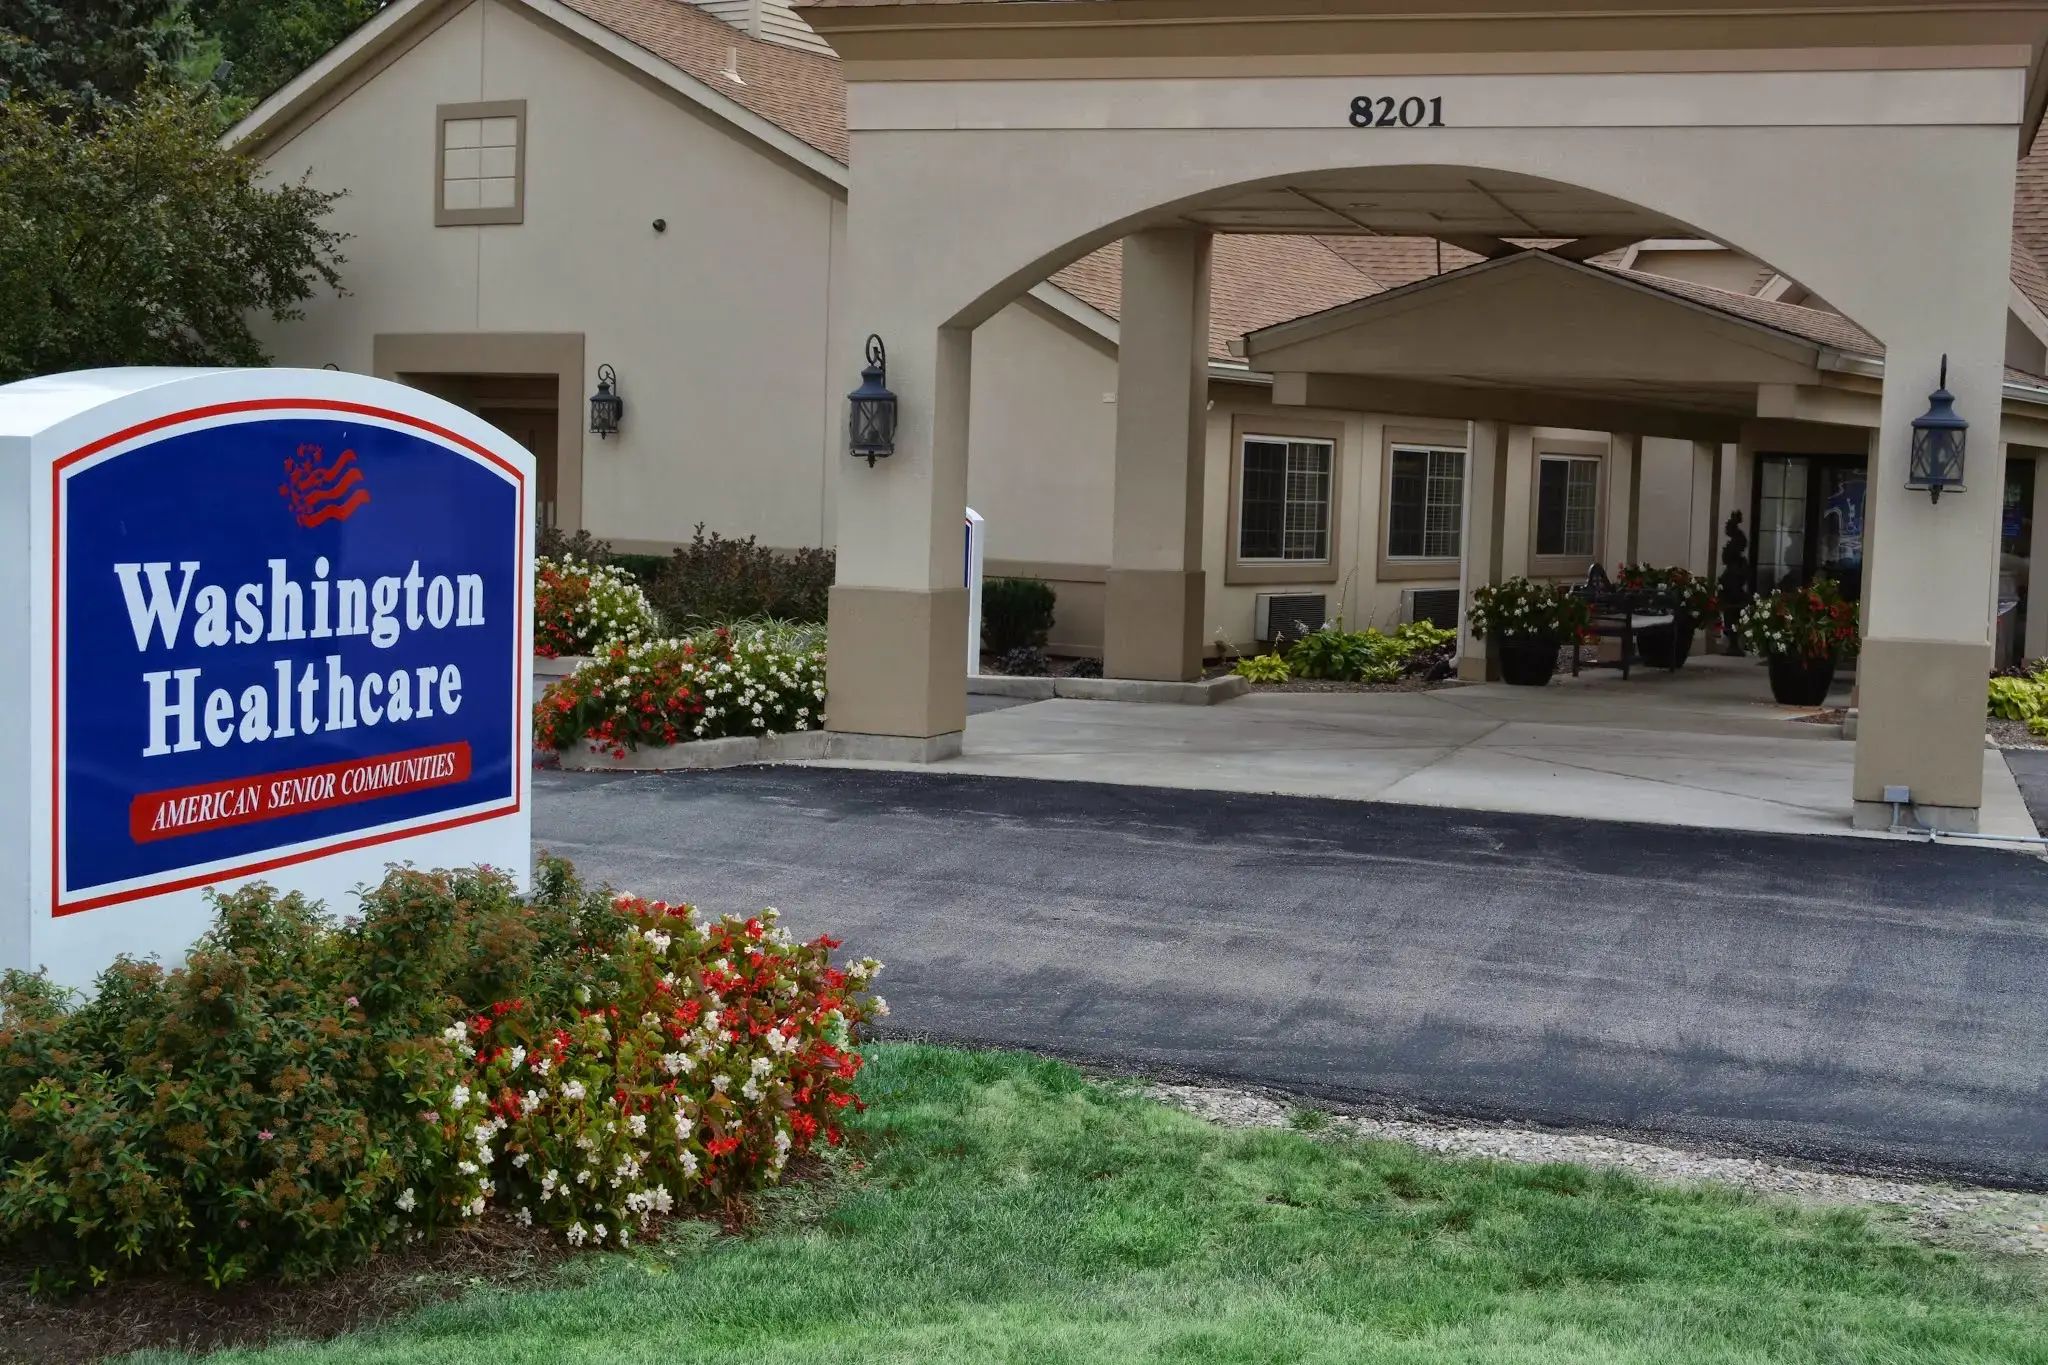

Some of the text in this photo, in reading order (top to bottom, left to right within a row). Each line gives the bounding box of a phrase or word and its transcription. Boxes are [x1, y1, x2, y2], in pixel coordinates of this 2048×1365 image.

[1349, 96, 1445, 128] 8201
[114, 556, 485, 652] Washington
[143, 655, 462, 757] Healthcare
[152, 752, 455, 831] AMERICAN SENIOR COMMUNITIES
